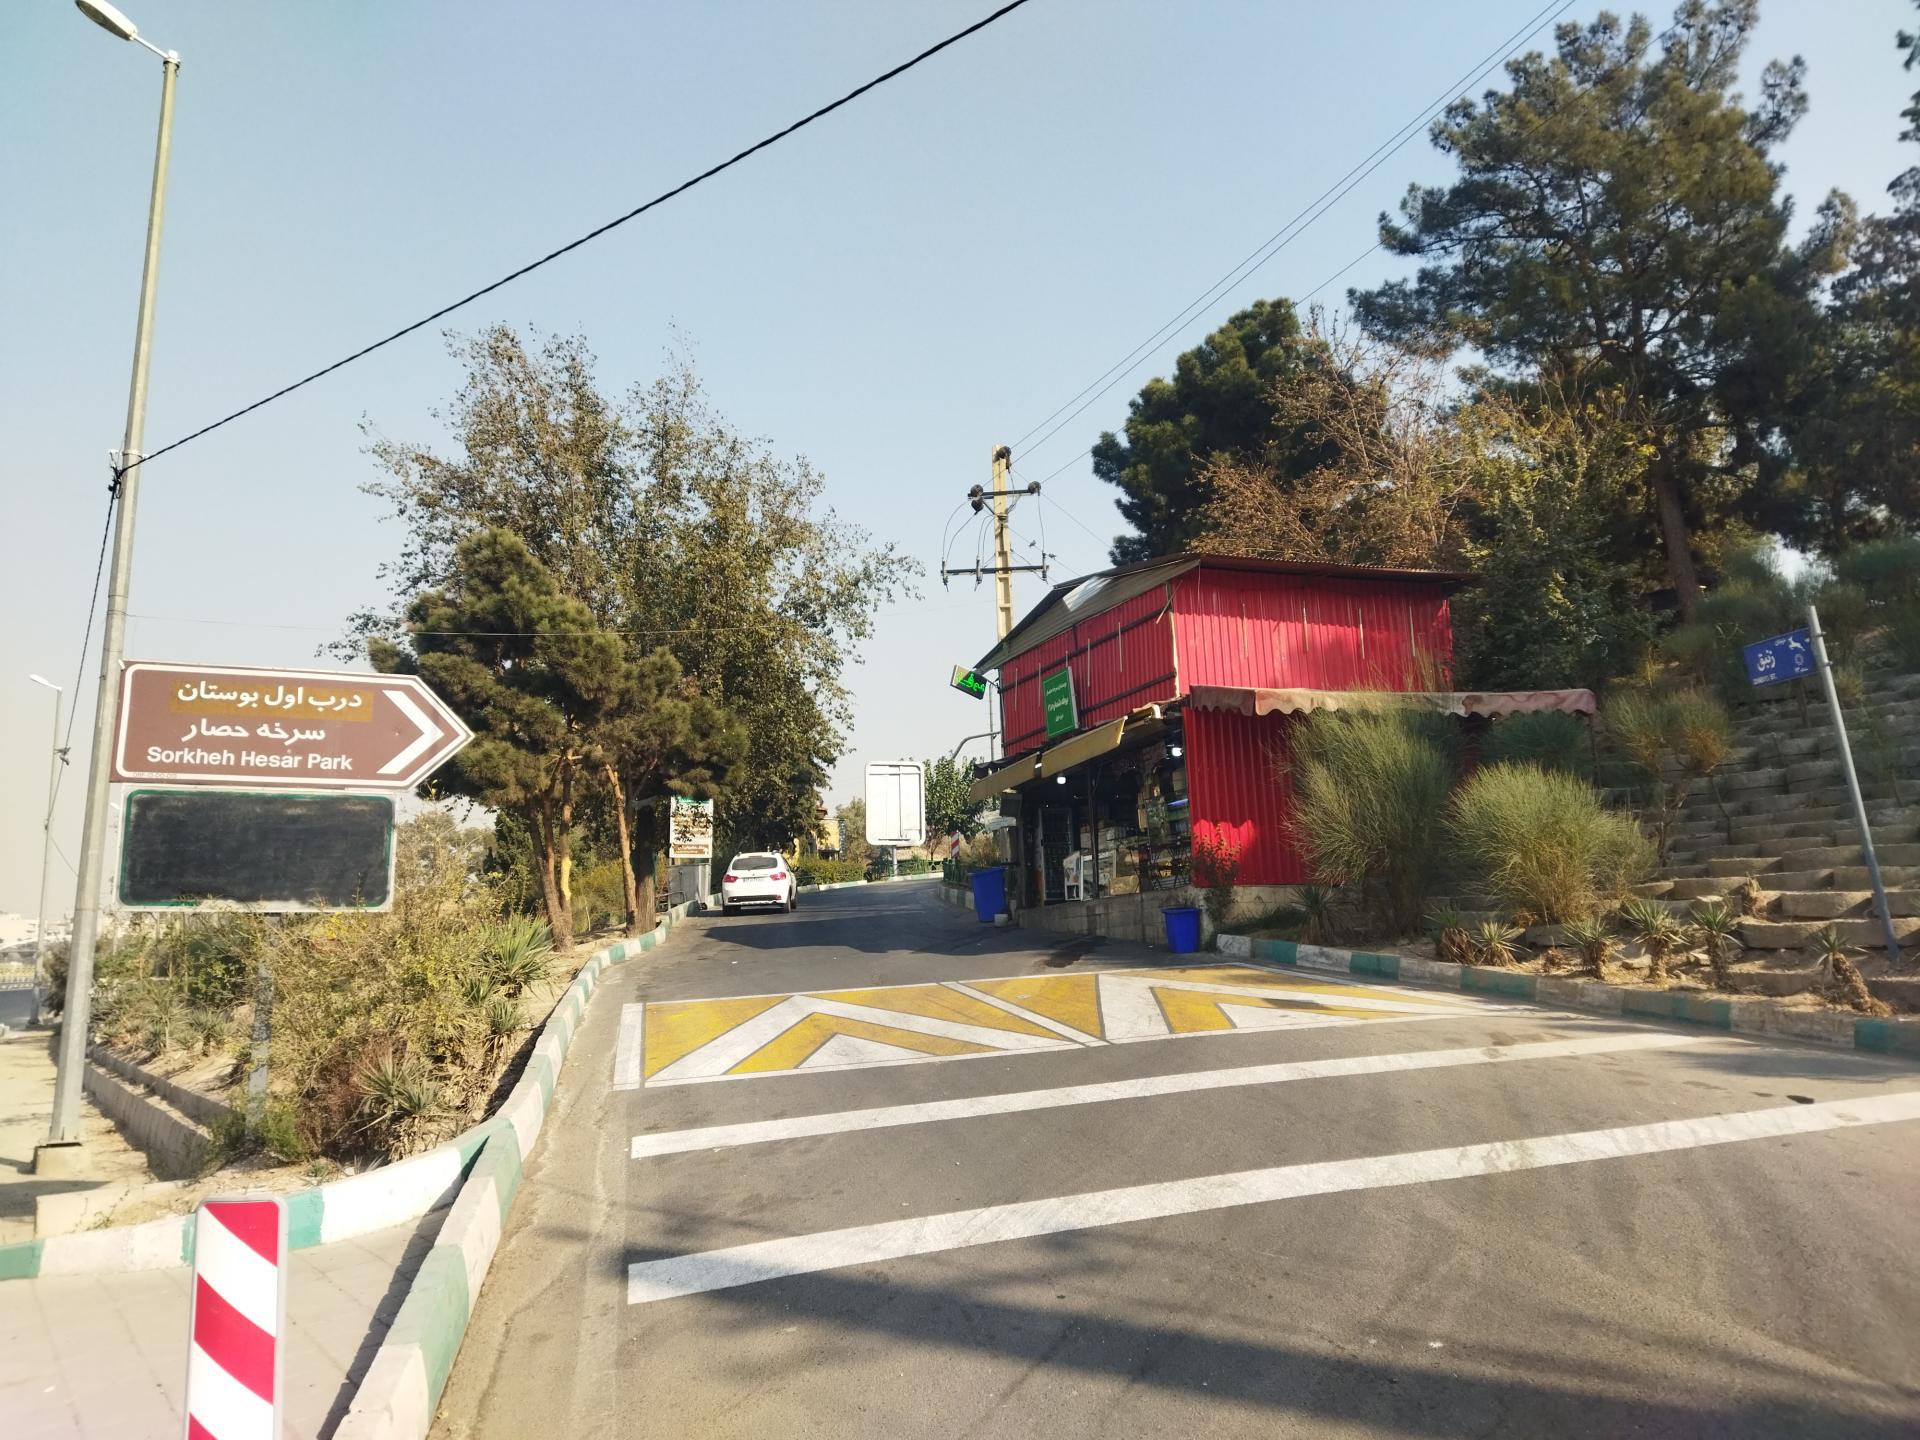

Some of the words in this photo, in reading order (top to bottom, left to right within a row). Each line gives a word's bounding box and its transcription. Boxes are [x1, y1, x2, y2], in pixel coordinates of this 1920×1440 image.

[177, 680, 259, 708] بوستان
[264, 685, 304, 709] اول
[308, 693, 362, 712] درب
[180, 718, 249, 742] حصار
[256, 721, 326, 746] سرخه
[146, 747, 235, 766] Sorkheh
[240, 750, 302, 769] Hesar
[307, 753, 353, 771] Park
